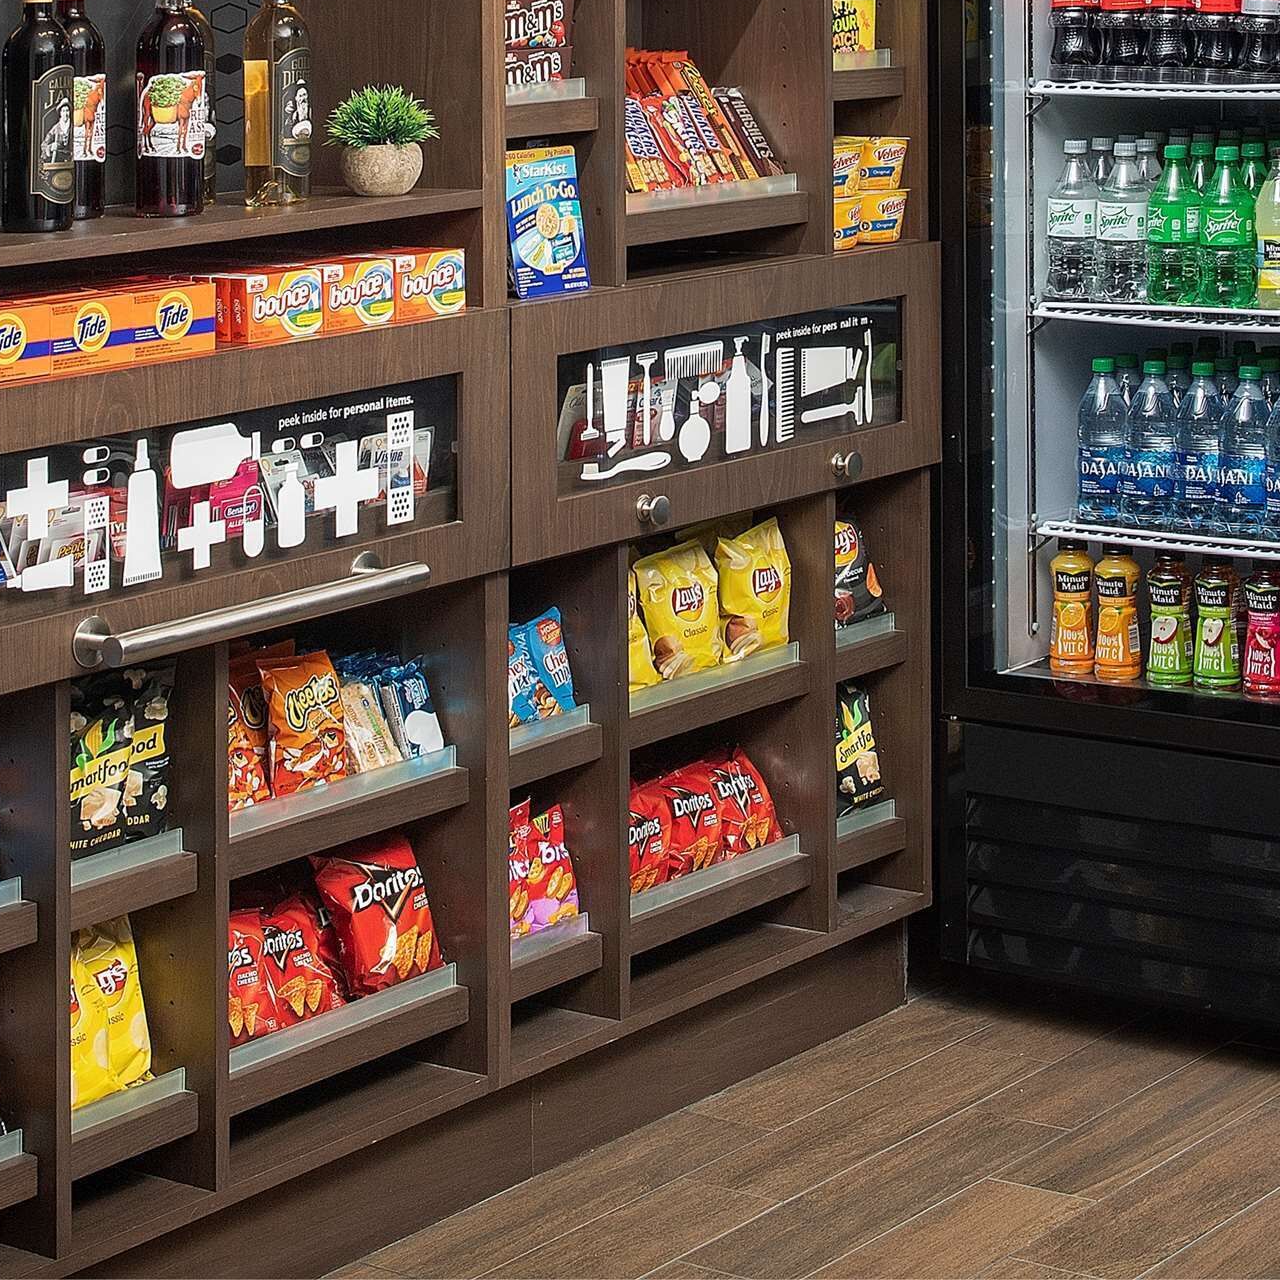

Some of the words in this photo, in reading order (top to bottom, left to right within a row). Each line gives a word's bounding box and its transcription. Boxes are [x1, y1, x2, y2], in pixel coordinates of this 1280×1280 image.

[732, 99, 774, 160] HERSHEY'S
[523, 162, 568, 179] StarKist
[511, 188, 544, 218] Lunch
[1048, 210, 1076, 226] Sprite
[1100, 214, 1129, 229] Sprite
[1206, 217, 1241, 232] Sprite
[329, 272, 384, 311] bounce
[401, 263, 456, 300] bounce
[253, 282, 311, 322] bounce
[159, 303, 188, 333] Tide
[77, 315, 107, 345] Tide
[775, 327, 792, 343] peek
[792, 324, 811, 339] inside
[811, 321, 822, 334] for
[278, 412, 301, 431] peek
[301, 407, 328, 425] inside
[328, 406, 342, 420] for
[343, 397, 385, 420] personal
[385, 394, 415, 410] items.
[755, 565, 780, 594] Lay's
[1058, 574, 1089, 584] Minute
[1062, 581, 1085, 591] Maid
[675, 582, 704, 614] Lay's
[1098, 586, 1120, 596] Maid
[1149, 584, 1180, 597] Minute
[1152, 593, 1175, 604] Maid
[1198, 586, 1226, 597] Minute
[1200, 595, 1222, 605] Maid
[1246, 591, 1277, 602] Minute
[1249, 600, 1273, 610] Maid
[683, 624, 709, 638] Classic
[286, 675, 339, 731] Cheetos
[717, 774, 756, 798] Doritos
[673, 793, 713, 817] Doritos
[629, 816, 660, 844] Doritos
